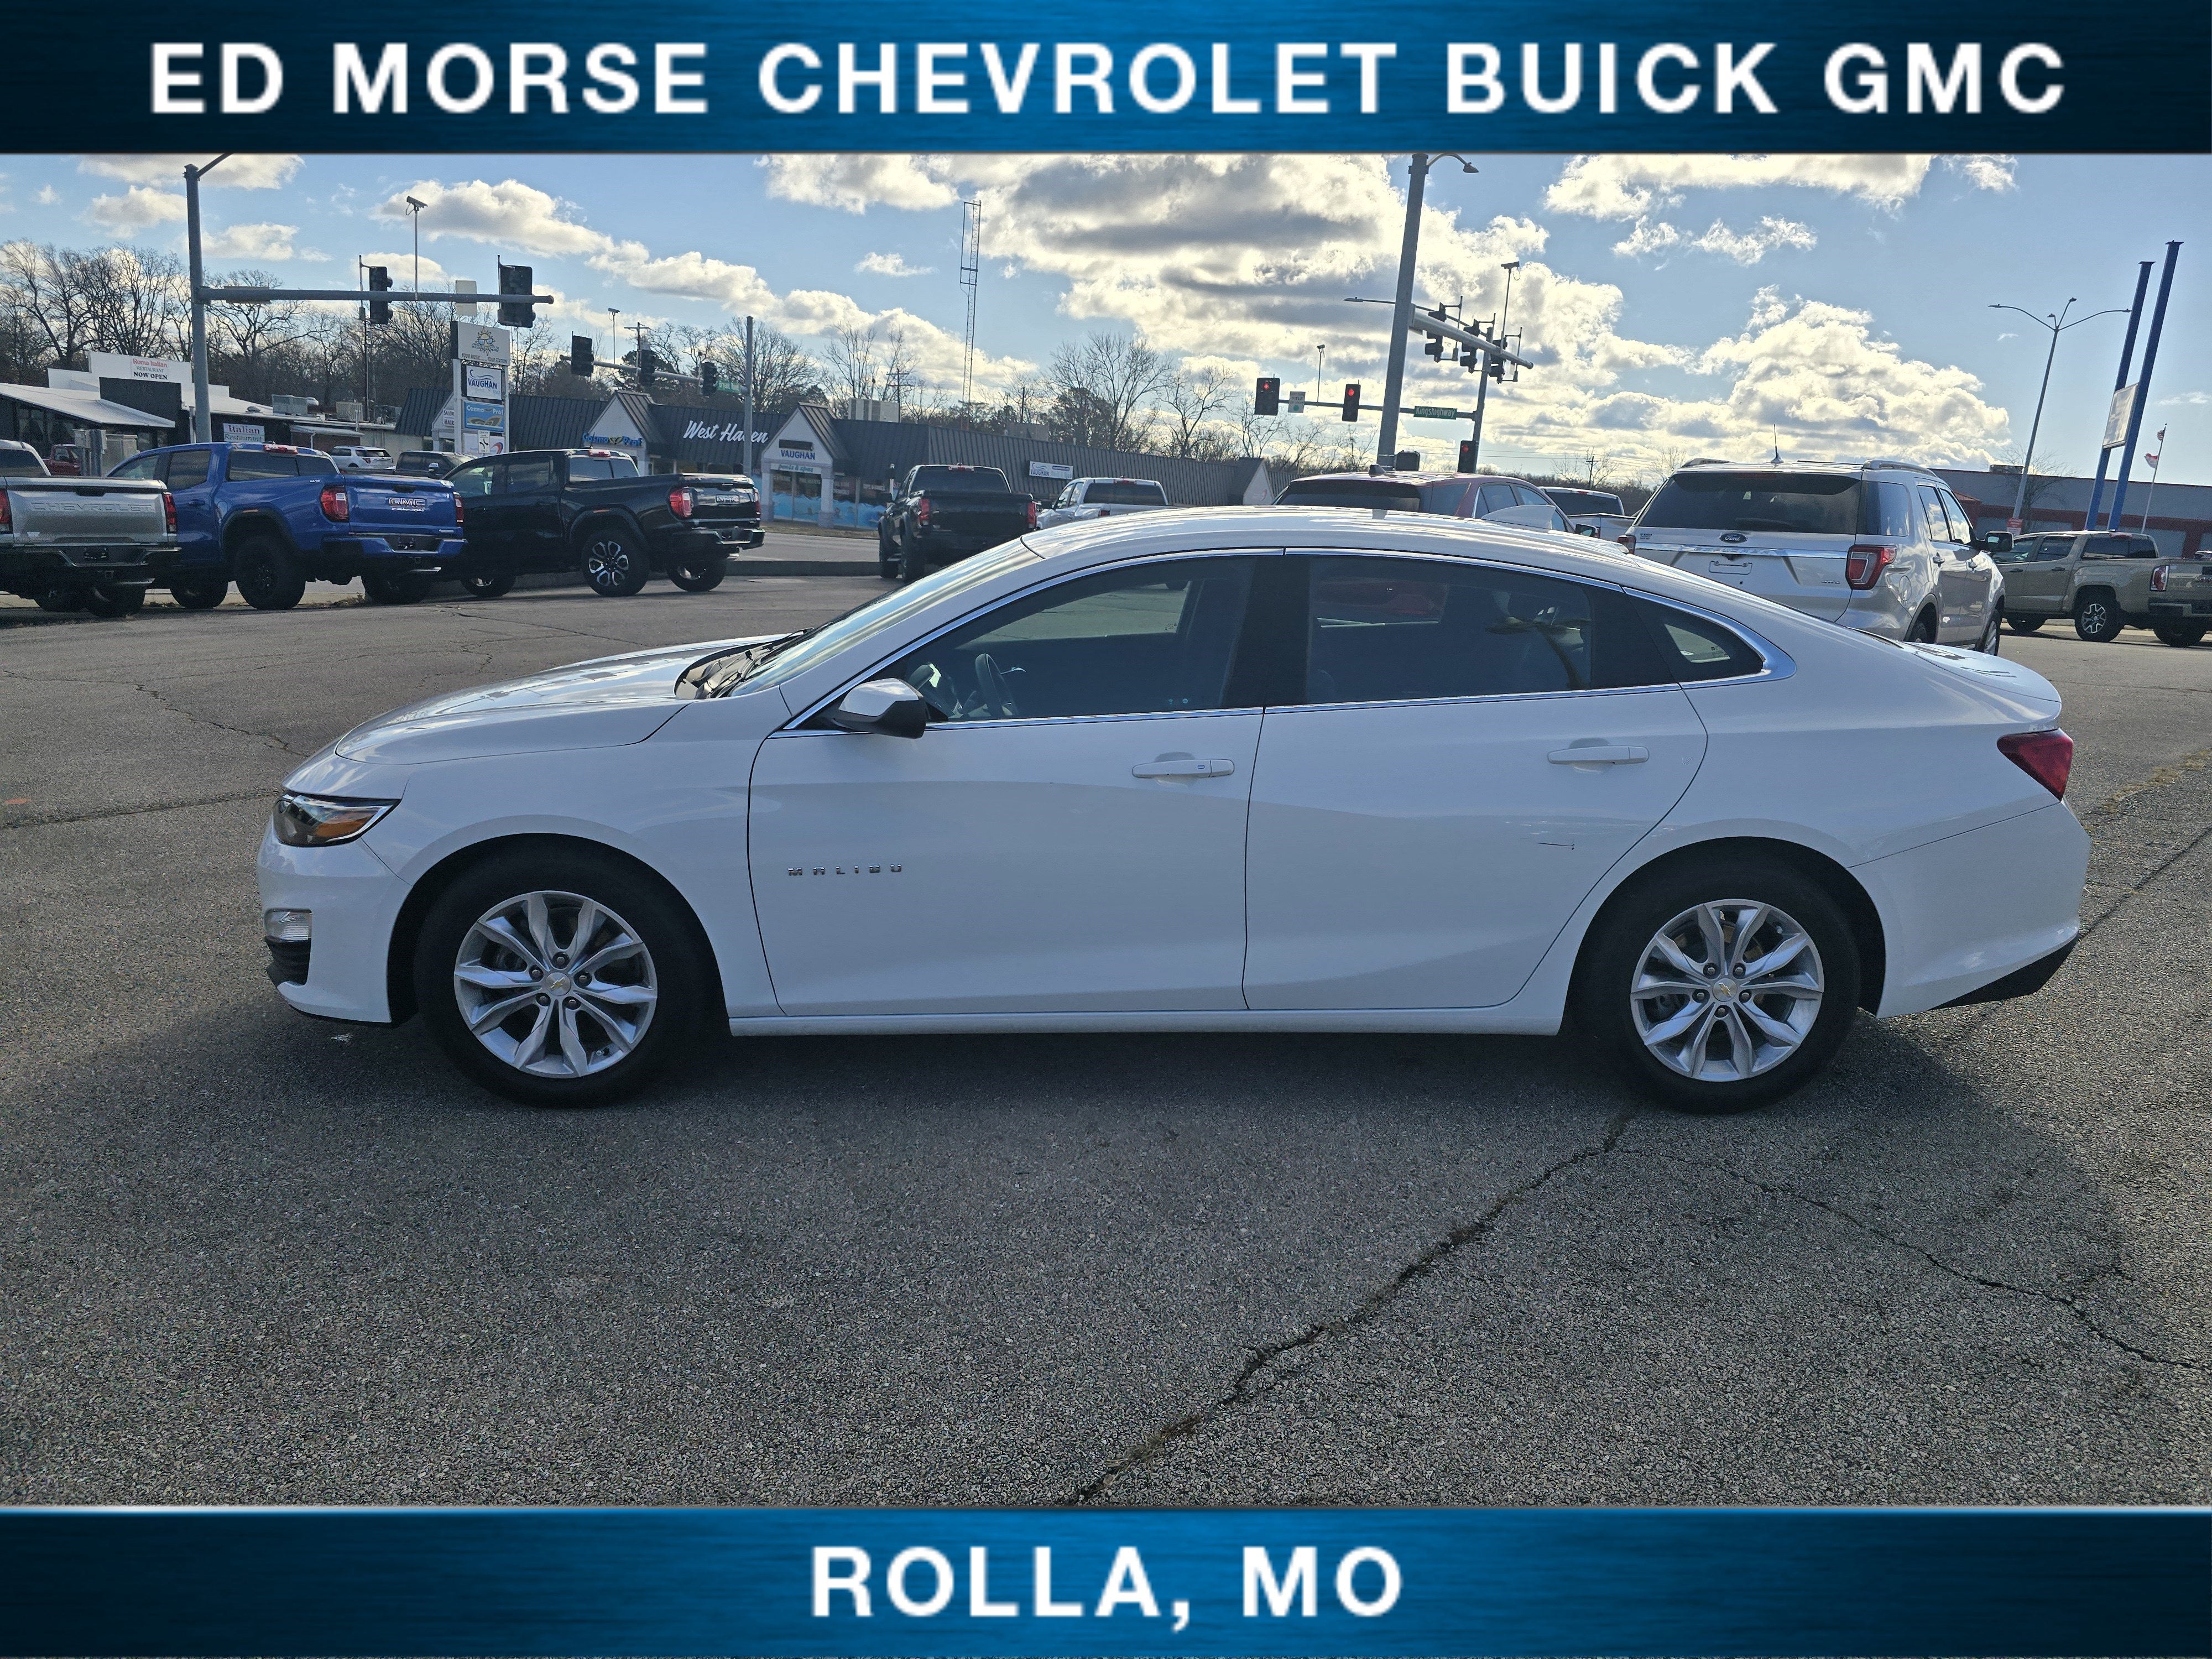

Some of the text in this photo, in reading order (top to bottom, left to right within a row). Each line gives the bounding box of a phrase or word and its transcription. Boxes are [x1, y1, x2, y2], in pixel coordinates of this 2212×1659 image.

[468, 378, 497, 389] VAUGHAN
[1416, 406, 1455, 419] Kingshighway
[228, 425, 260, 434] Italian
[683, 420, 769, 444] West Haen
[780, 450, 816, 460] VAUGHAN
[30, 502, 156, 513] CHEVROLET
[388, 497, 426, 507] GMC
[787, 864, 902, 876] MALIBU
